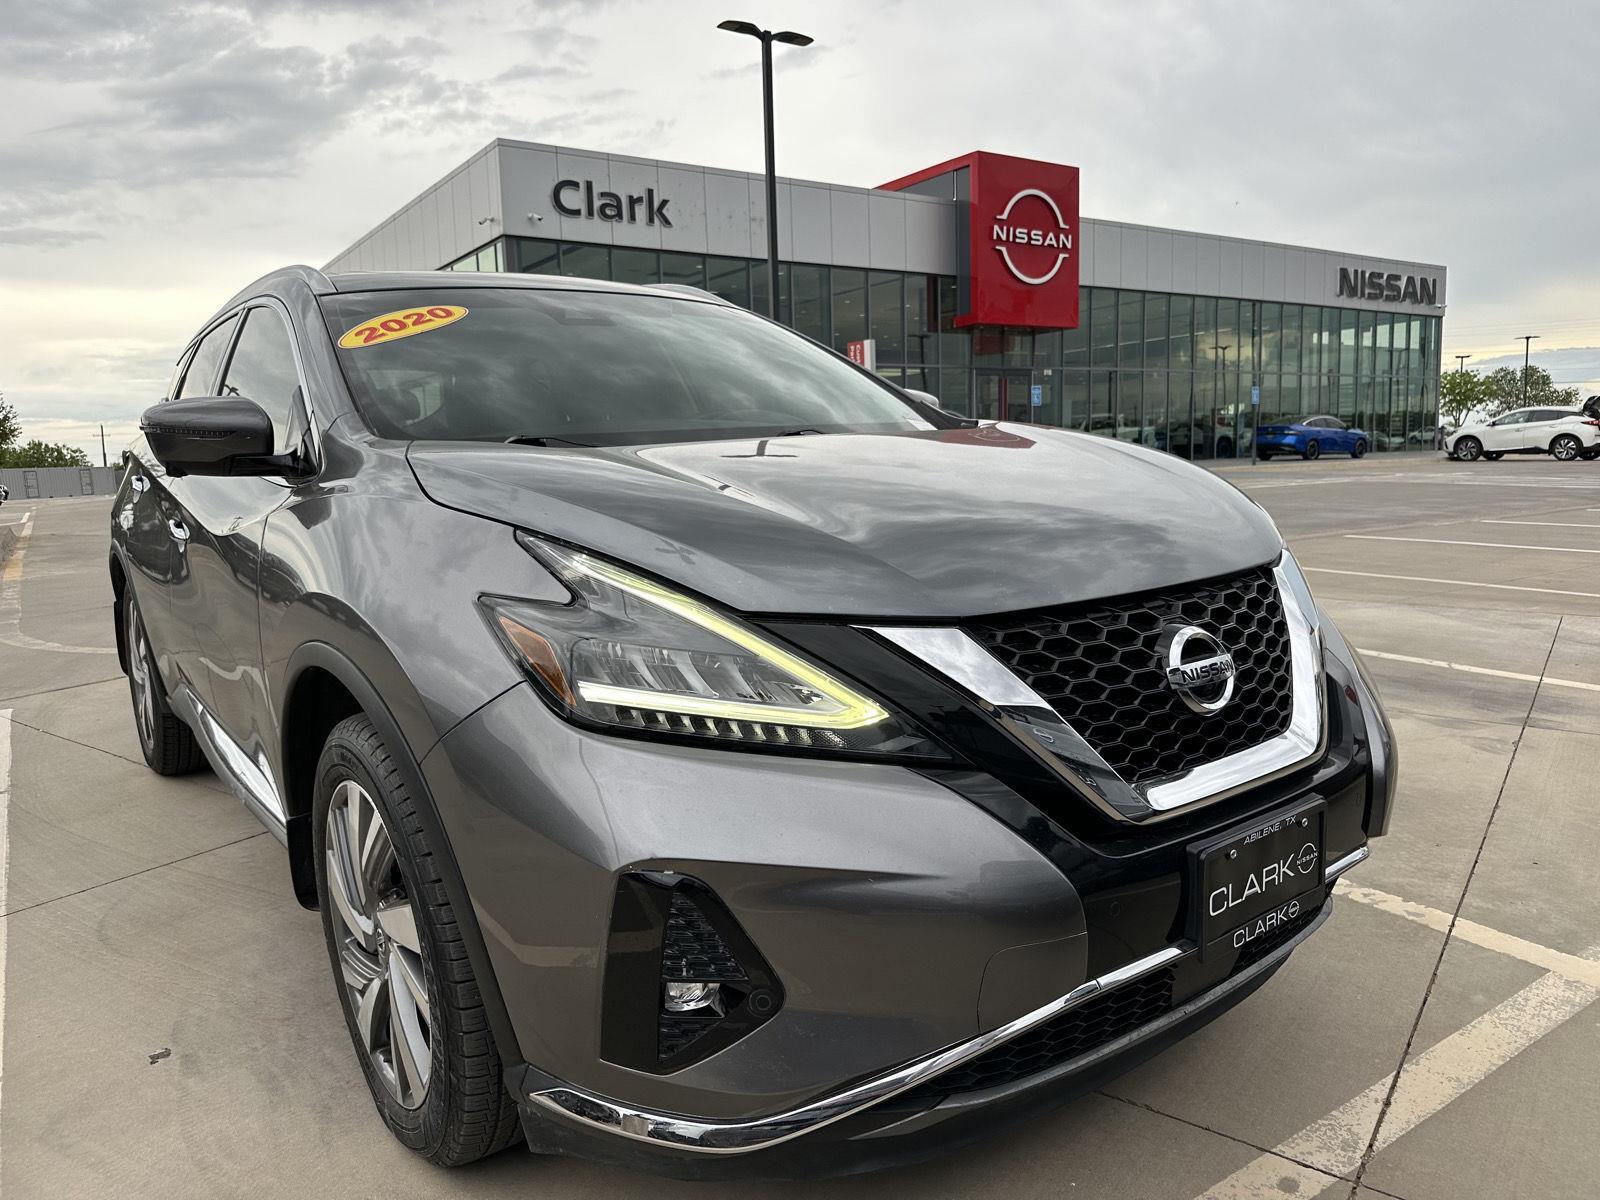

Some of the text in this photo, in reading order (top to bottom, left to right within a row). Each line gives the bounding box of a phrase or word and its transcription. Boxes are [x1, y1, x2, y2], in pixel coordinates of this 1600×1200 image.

[552, 179, 674, 228] Clark
[993, 224, 1072, 249] NISSAN
[1338, 267, 1437, 305] NISSAN
[354, 306, 455, 345] 2020
[1181, 658, 1234, 683] NISSAN
[1285, 815, 1297, 826] TX
[1296, 851, 1318, 866] NISSAN
[1209, 853, 1295, 917] CLARK
[1233, 906, 1287, 948] CLARK
